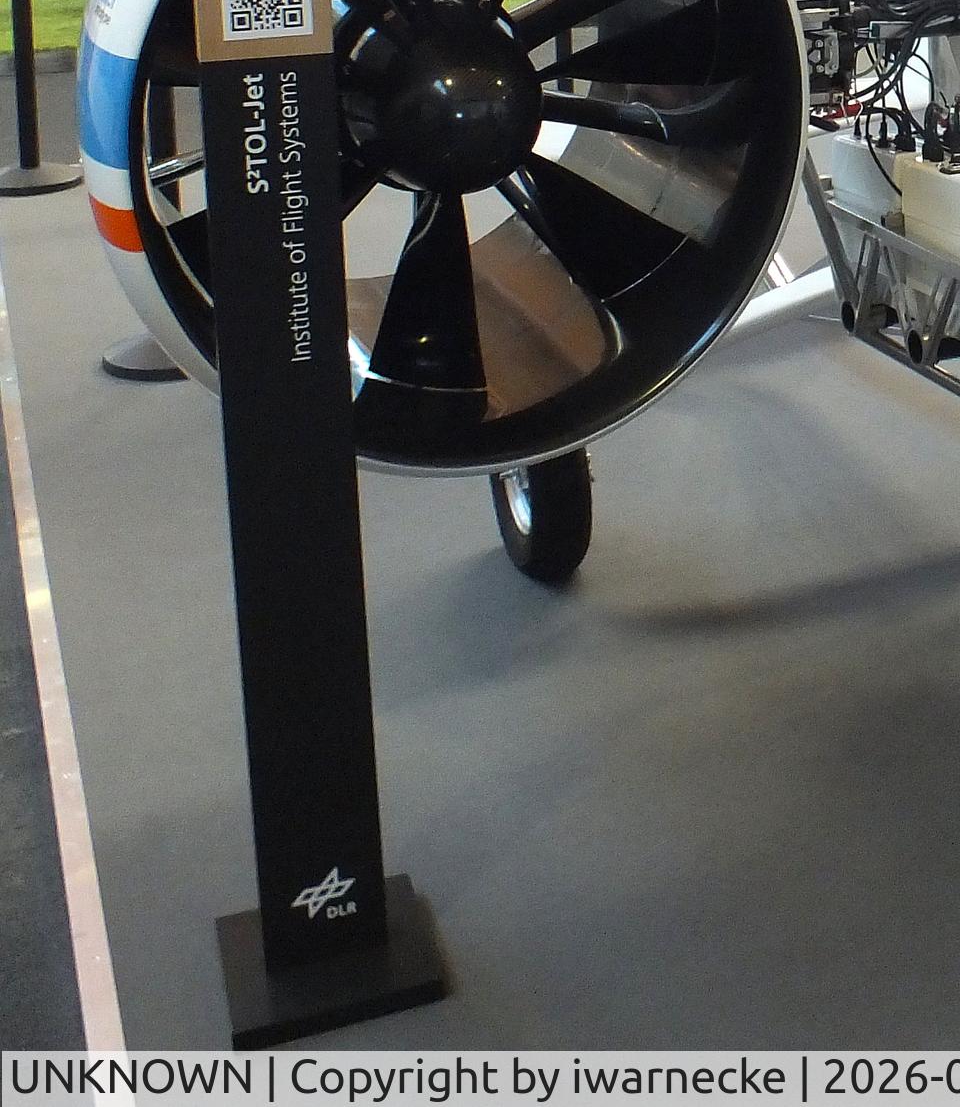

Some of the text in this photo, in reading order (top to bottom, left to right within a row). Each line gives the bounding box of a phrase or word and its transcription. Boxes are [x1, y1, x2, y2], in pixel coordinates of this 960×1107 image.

[279, 71, 311, 362] Institute of Flight Systems
[326, 901, 357, 919] DLR
